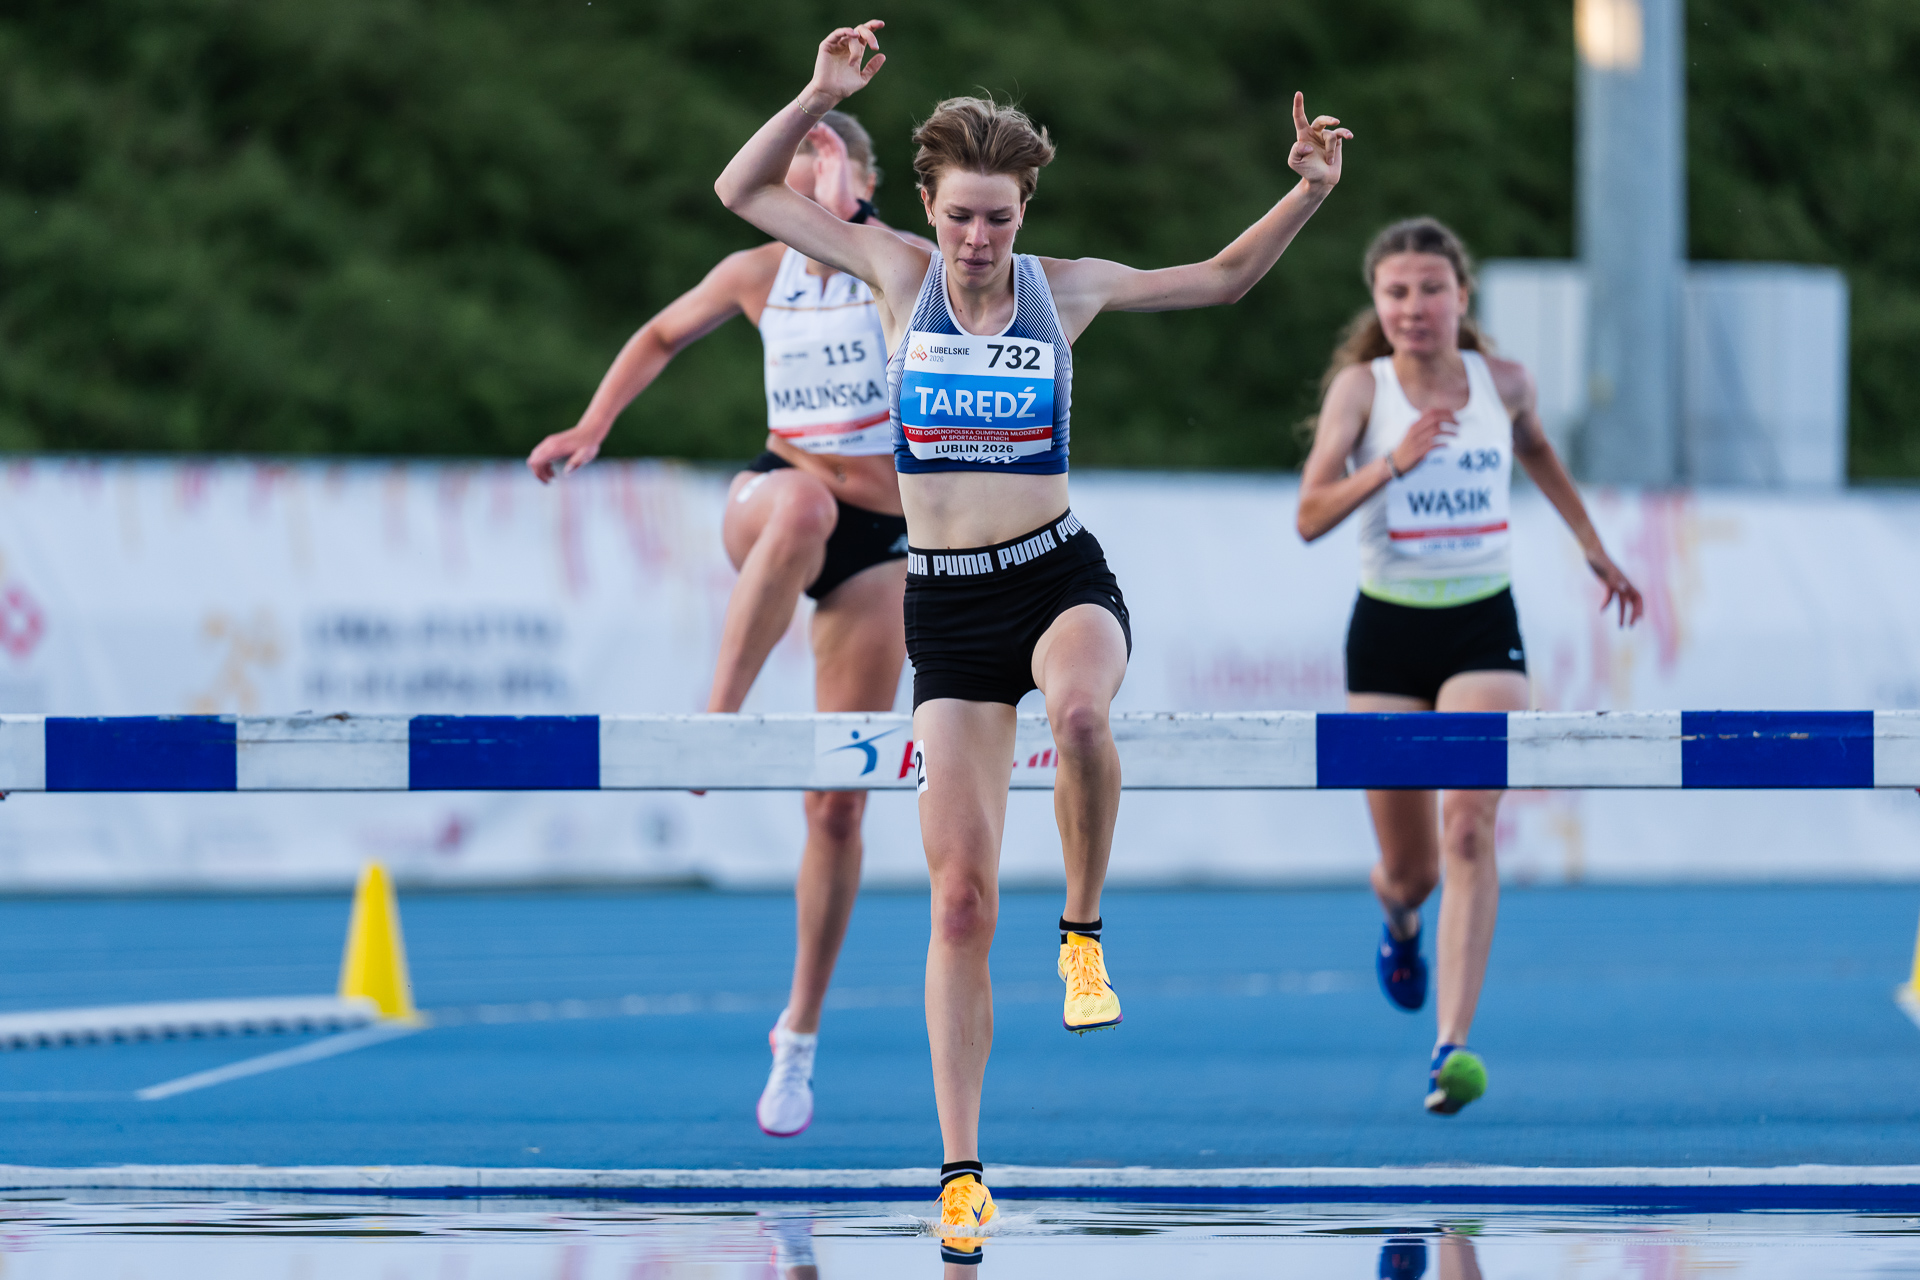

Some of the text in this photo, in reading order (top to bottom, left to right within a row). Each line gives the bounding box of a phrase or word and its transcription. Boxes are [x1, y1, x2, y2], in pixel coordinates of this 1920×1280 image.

[823, 341, 866, 365] 115
[930, 345, 970, 355] LUBELSKIE
[987, 344, 1040, 370] 732
[773, 379, 882, 412] MALIŃSKA
[915, 386, 1036, 422] TARĘDŹ
[924, 428, 974, 436] OGÓLNOPOLSKA
[1010, 428, 1044, 436] MŁODZIEŻY
[935, 444, 1014, 454] LUBLIN 2026
[1458, 449, 1501, 471] 430
[1407, 488, 1491, 517] WĄSIK
[908, 511, 1083, 576] MA PUMA PUMA PUM
